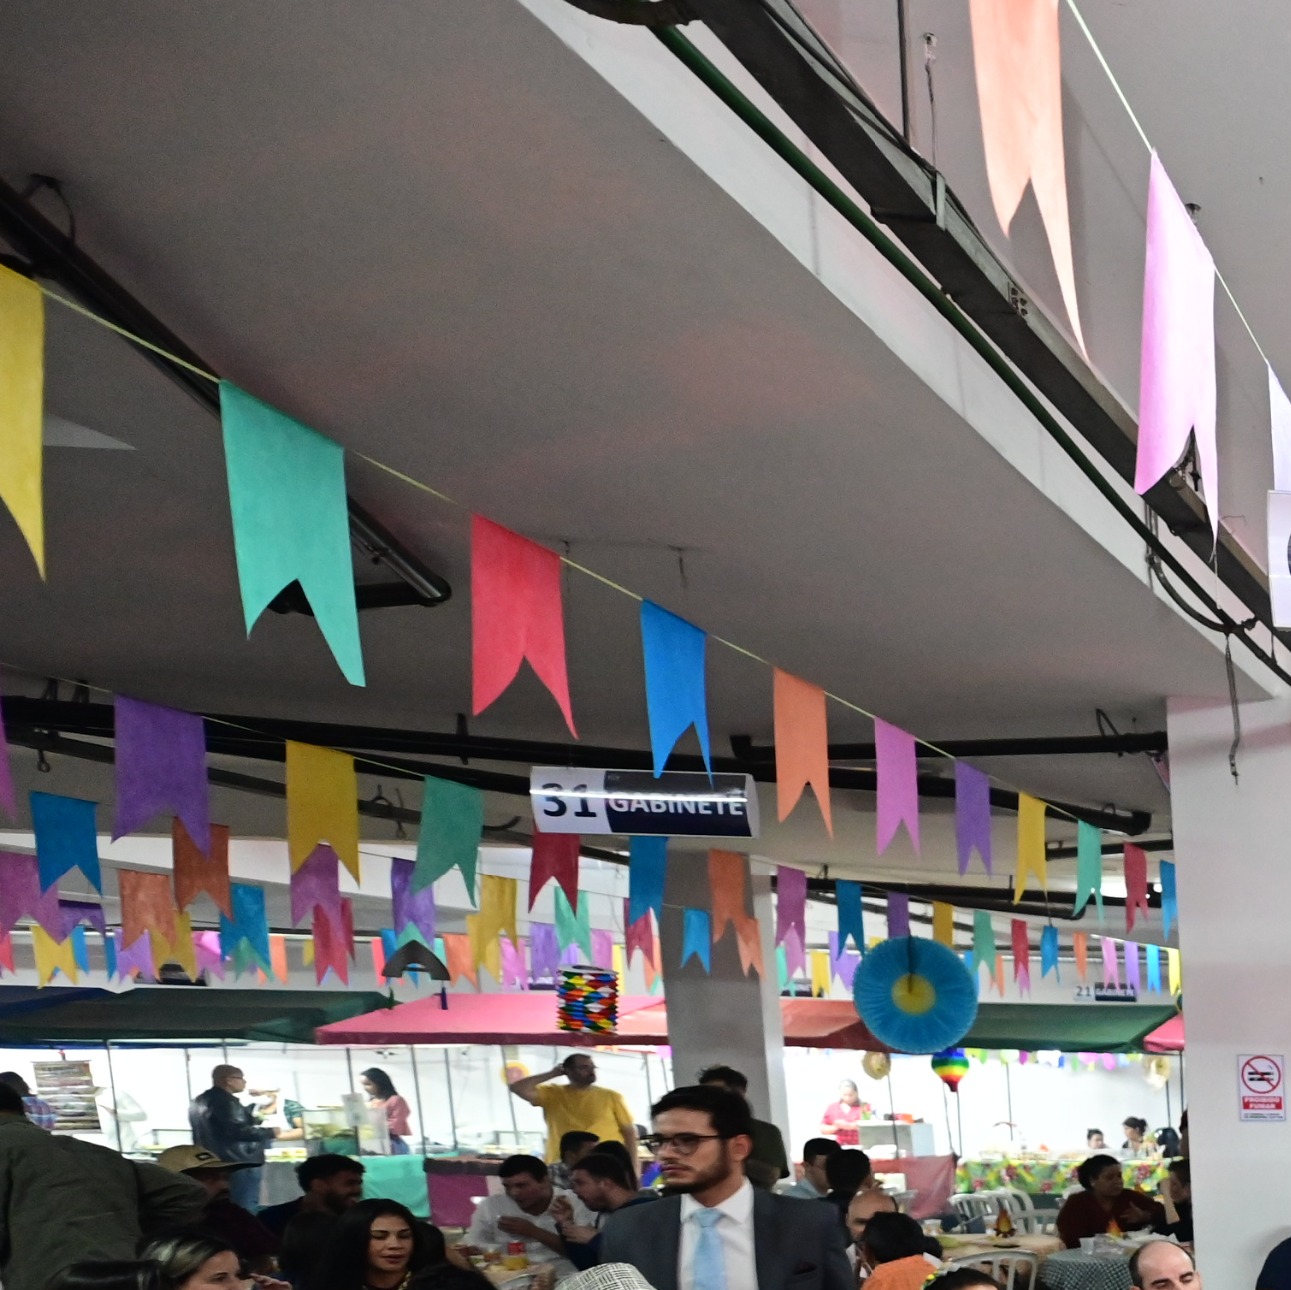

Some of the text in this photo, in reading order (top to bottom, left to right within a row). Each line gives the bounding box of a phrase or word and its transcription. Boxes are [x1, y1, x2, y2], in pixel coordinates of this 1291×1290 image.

[541, 782, 744, 818] 31 GABINETE
[1076, 985, 1091, 997] 21
